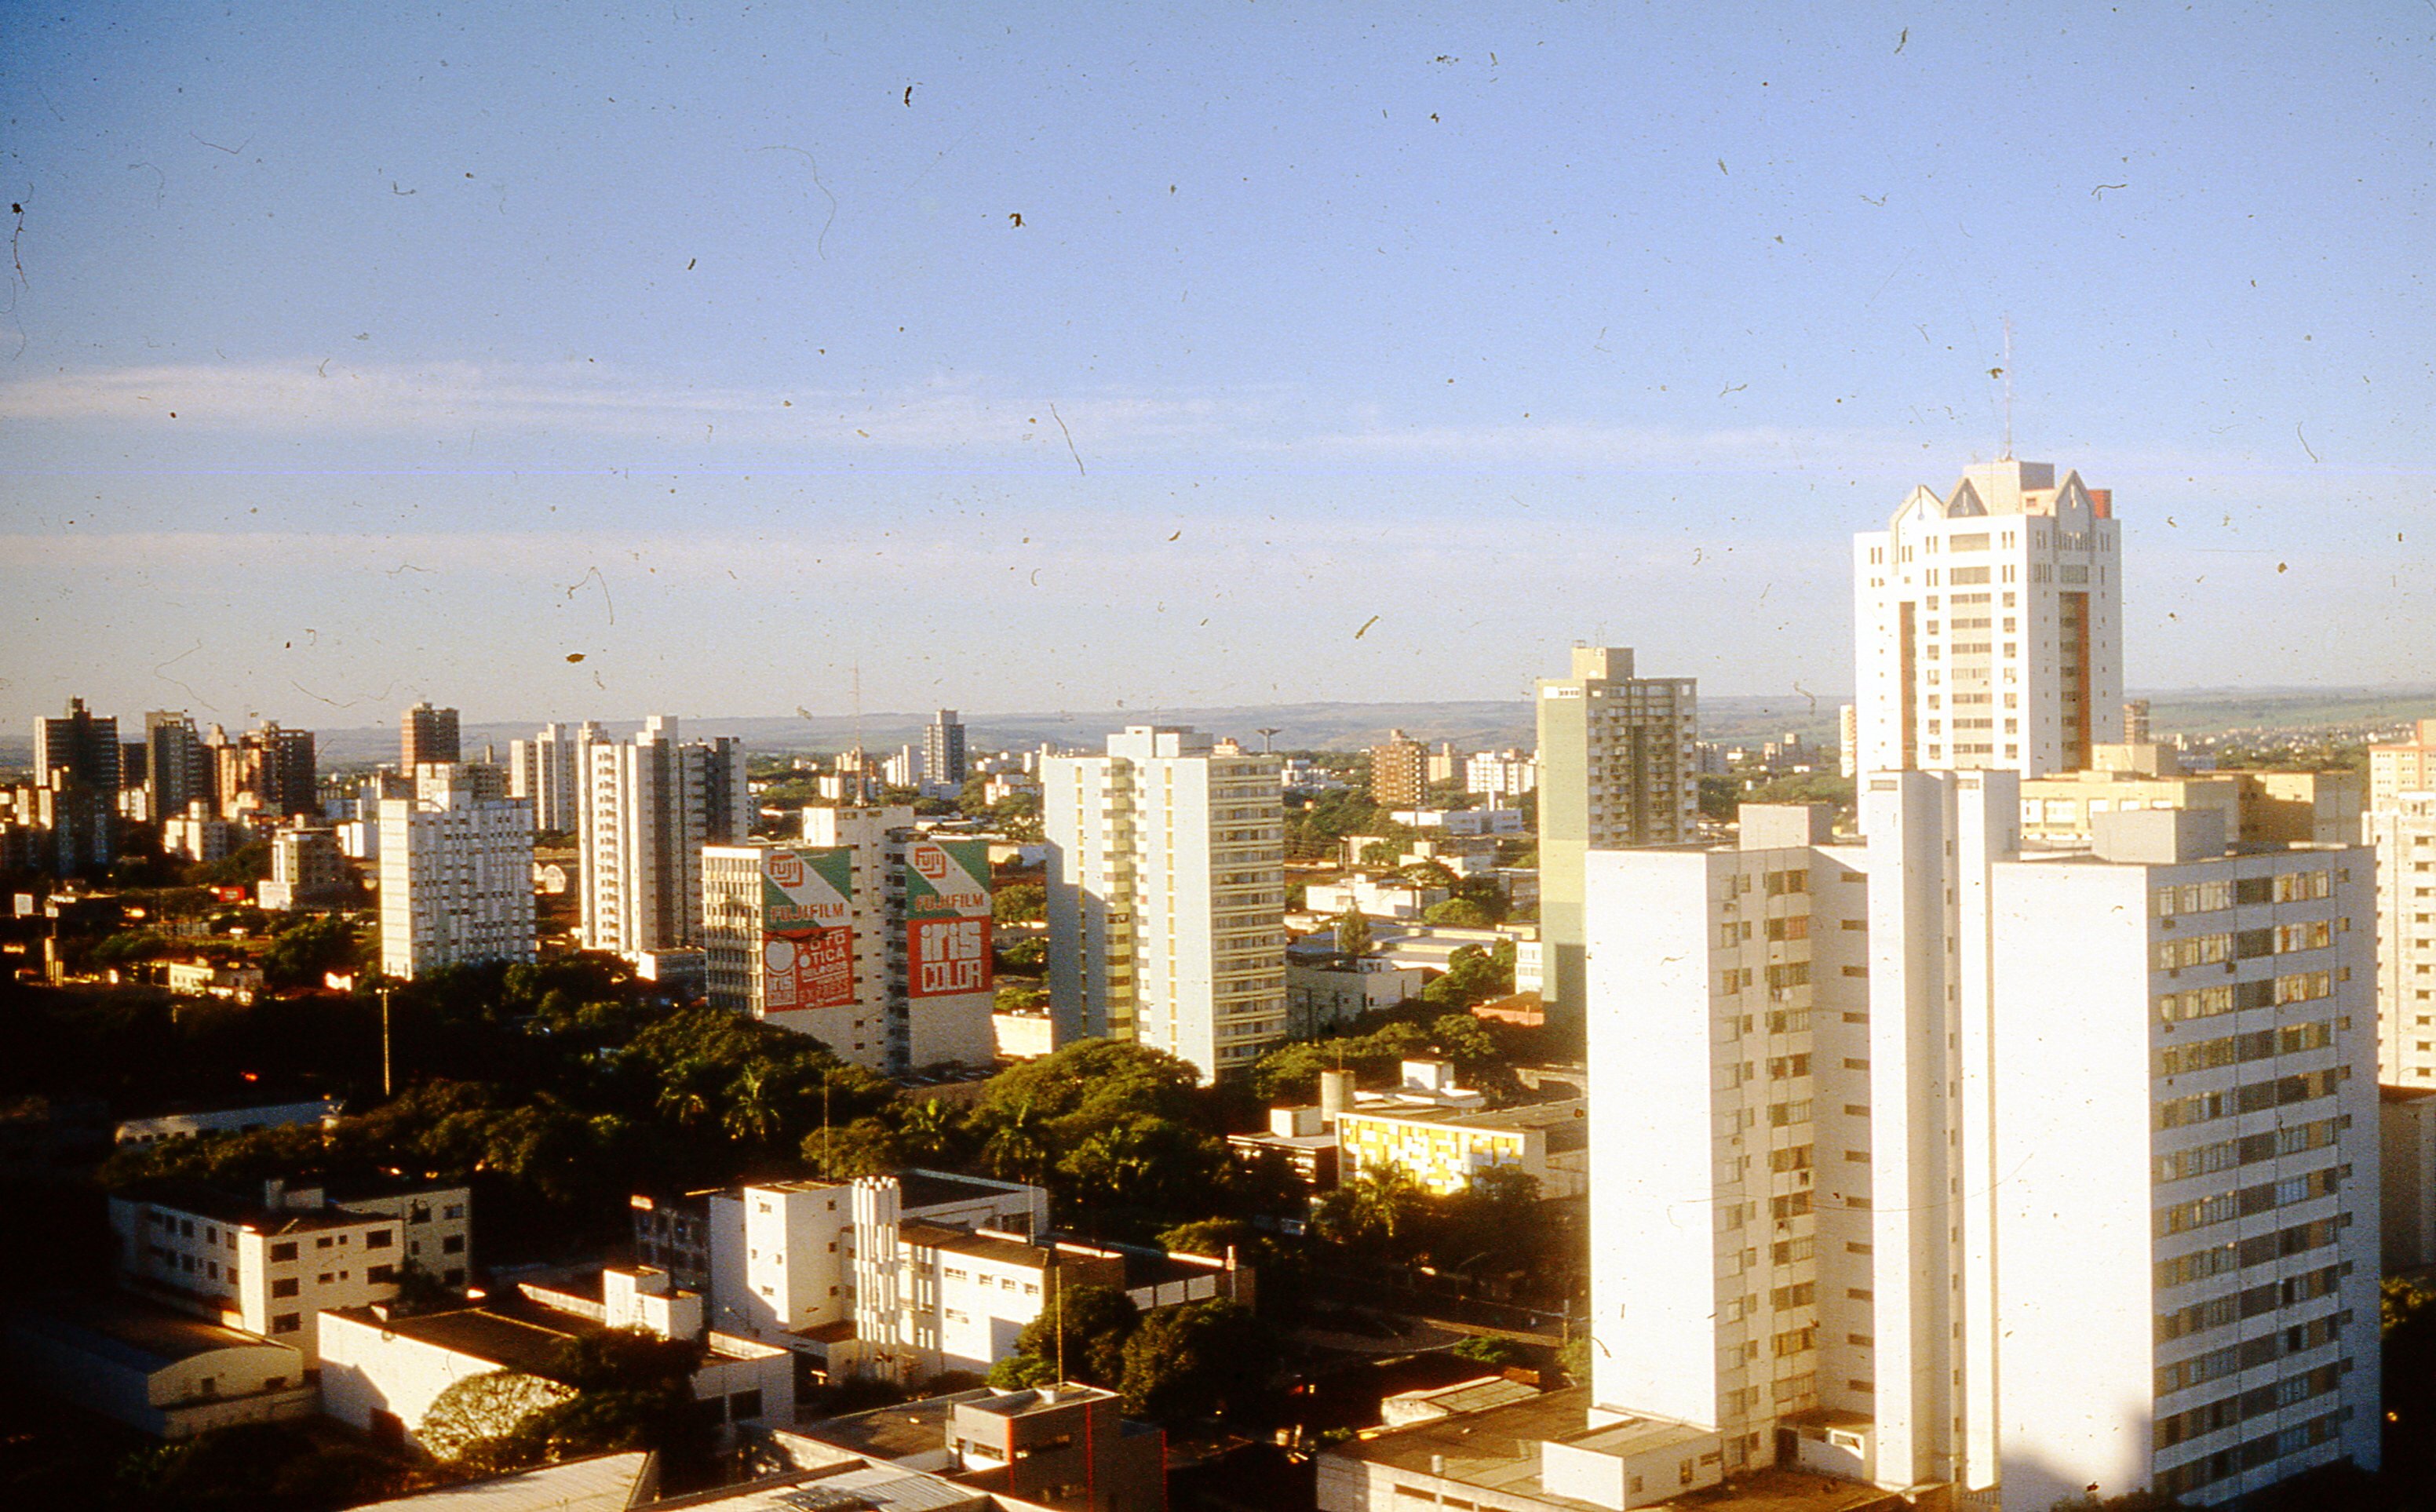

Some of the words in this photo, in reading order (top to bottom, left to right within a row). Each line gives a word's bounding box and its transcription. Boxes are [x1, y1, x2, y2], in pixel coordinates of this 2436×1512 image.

[770, 854, 804, 887] FUJI
[915, 847, 946, 879] FUJI
[771, 902, 844, 922] FUJIFILM
[916, 893, 984, 910] FUJIFILM
[922, 959, 982, 993] COLOR
